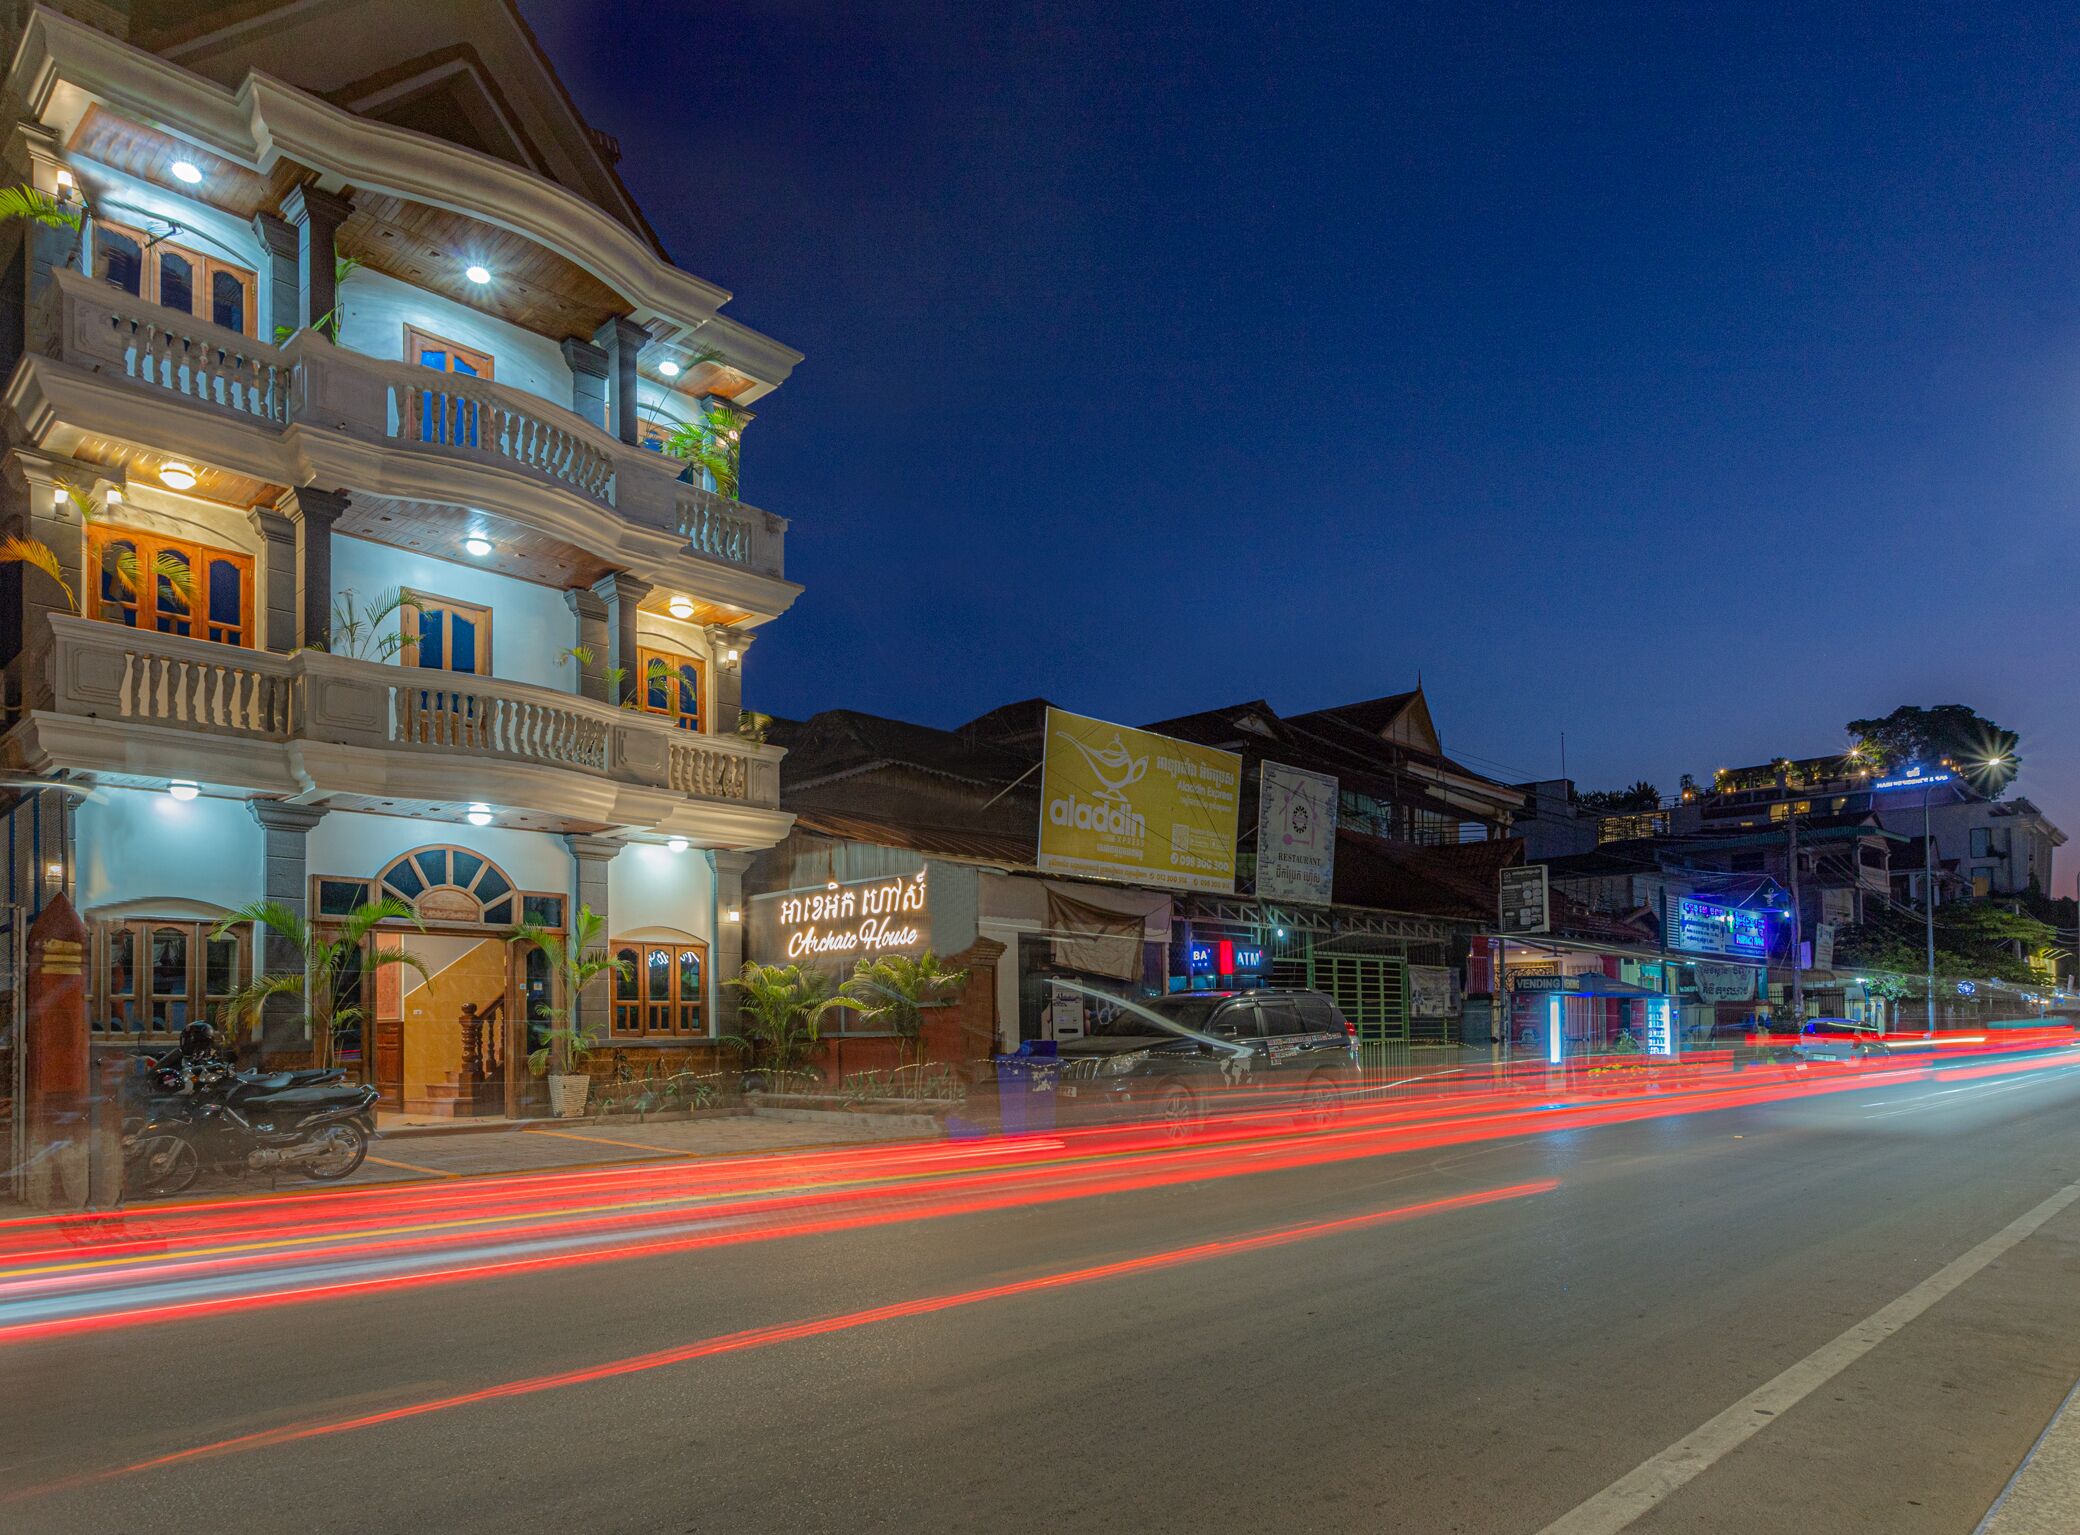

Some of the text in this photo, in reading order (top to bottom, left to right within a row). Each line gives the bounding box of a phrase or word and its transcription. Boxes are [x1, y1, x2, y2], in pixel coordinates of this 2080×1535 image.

[1177, 780, 1233, 801] Aladdin Express
[1049, 793, 1145, 838] aladdin
[1278, 852, 1321, 866] RESTAURANT
[788, 916, 918, 958] Archaic House
[1193, 950, 1260, 966] BA ATM
[1515, 978, 1561, 989] VENDING
